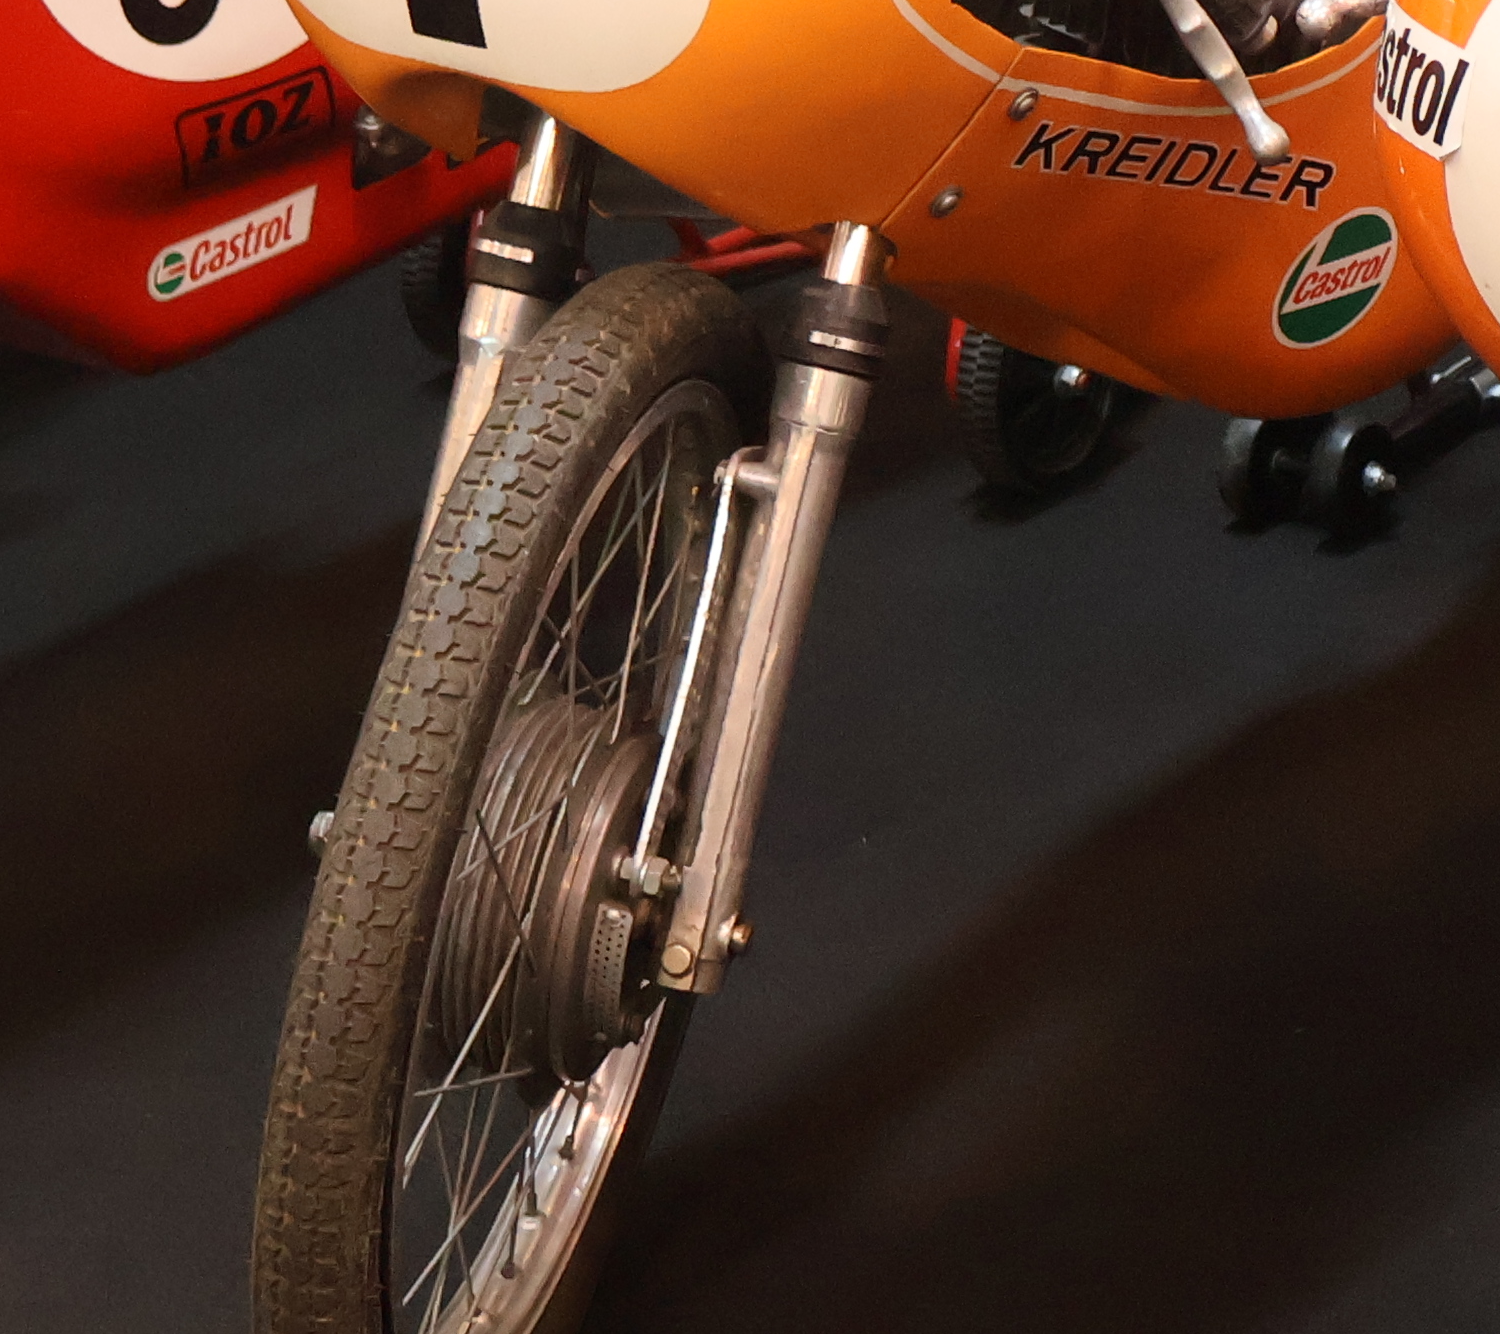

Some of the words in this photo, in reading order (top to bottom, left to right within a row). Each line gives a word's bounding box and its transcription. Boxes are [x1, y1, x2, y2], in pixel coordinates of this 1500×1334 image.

[1012, 122, 1336, 210] KREIDLER
[191, 205, 294, 282] Castrol
[1291, 248, 1391, 306] Castrol
